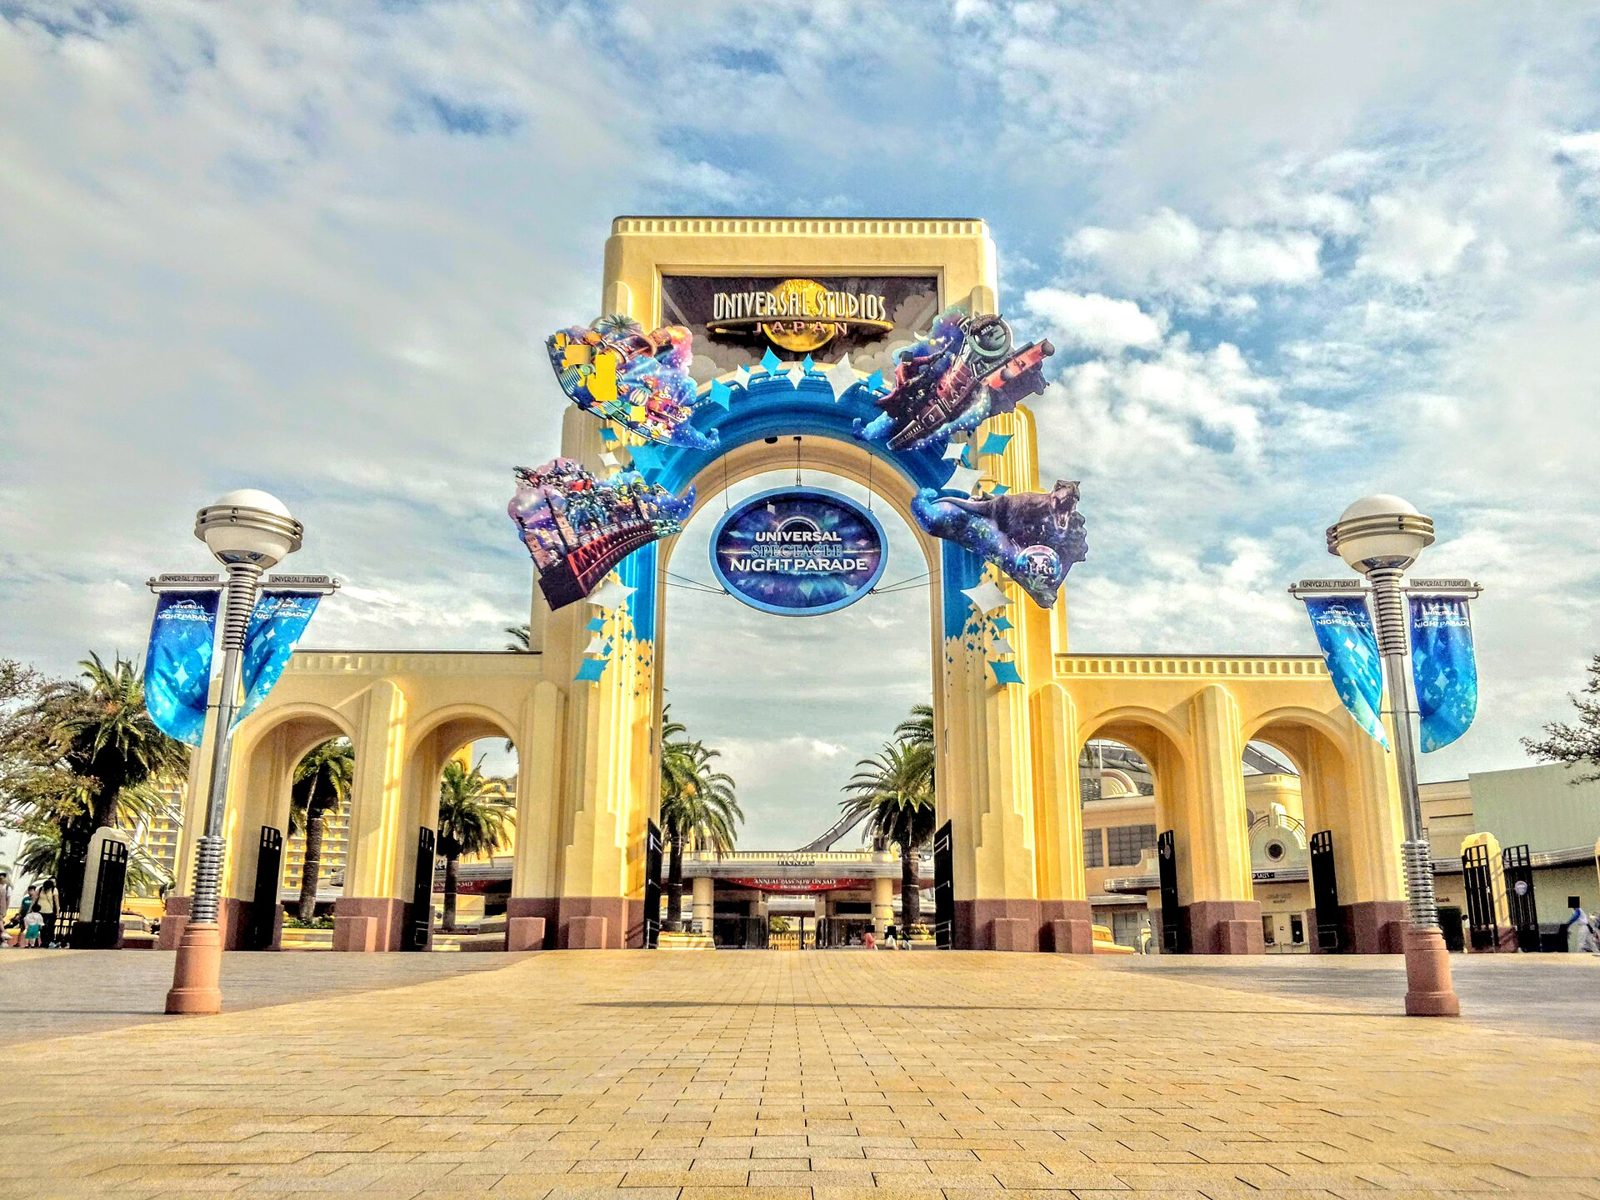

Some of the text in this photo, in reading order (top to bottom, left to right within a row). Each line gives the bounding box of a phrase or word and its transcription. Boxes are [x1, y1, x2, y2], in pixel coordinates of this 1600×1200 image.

[713, 291, 887, 321] UNIVERSAL STUDIOS
[753, 321, 848, 335] JAPAN
[755, 531, 842, 542] UNIVERSAL
[751, 544, 843, 558] SPECTACLE
[730, 558, 869, 572] NIGHT PARADE
[271, 575, 300, 583] UNIVERSAL
[1302, 580, 1333, 588] UNIVERSAL
